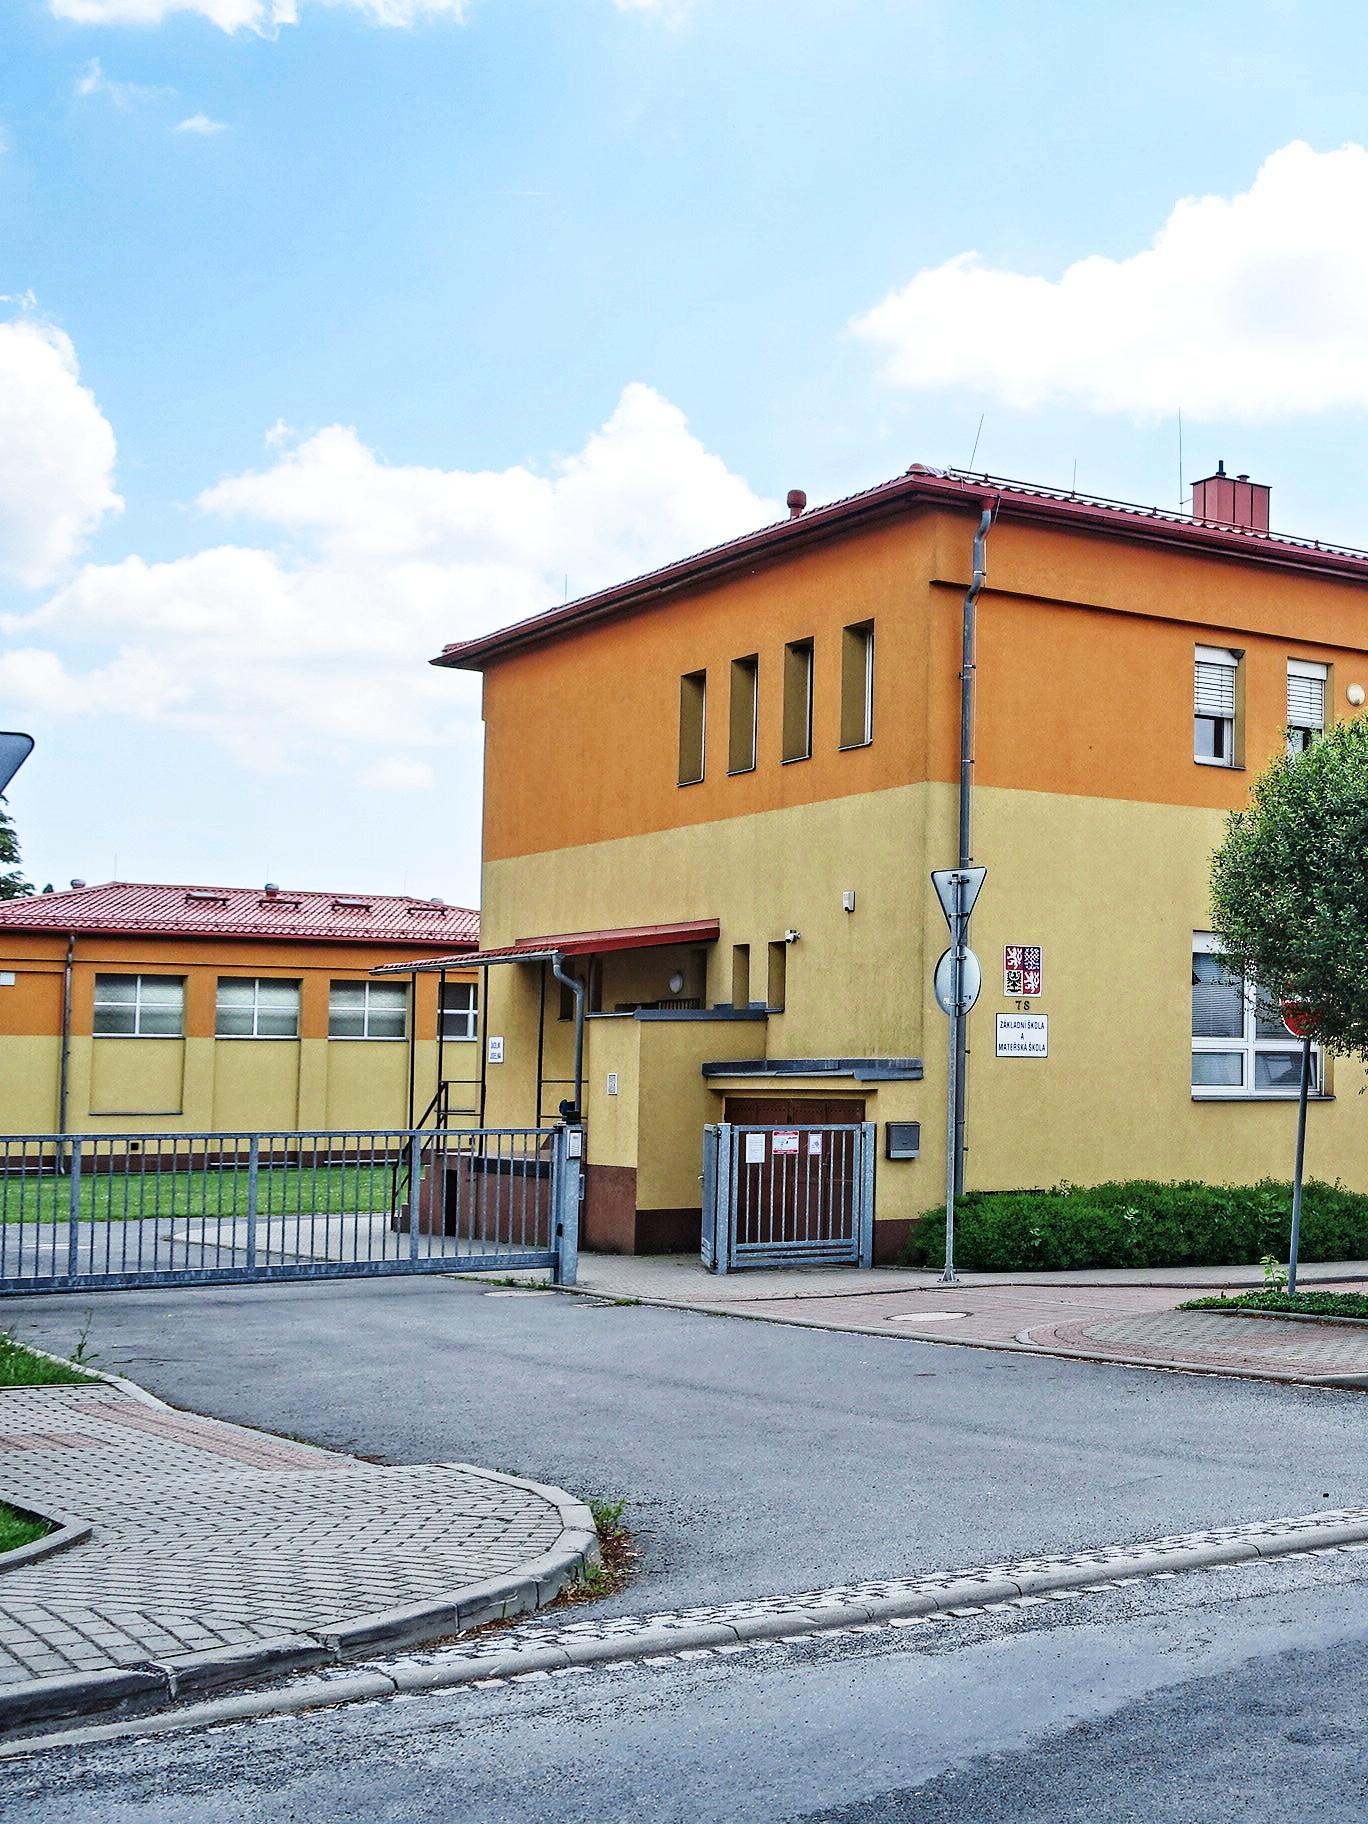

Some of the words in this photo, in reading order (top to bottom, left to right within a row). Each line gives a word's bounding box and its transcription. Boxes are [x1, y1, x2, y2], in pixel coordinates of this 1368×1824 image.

[1000, 1019, 1027, 1029] ZÁKLADNÍ
[1027, 1020, 1045, 1030] ŠKOLA
[1020, 1032, 1025, 1040] A
[998, 1042, 1028, 1051] MATEŘSKÁ
[1028, 1042, 1046, 1052] ŠKOLA
